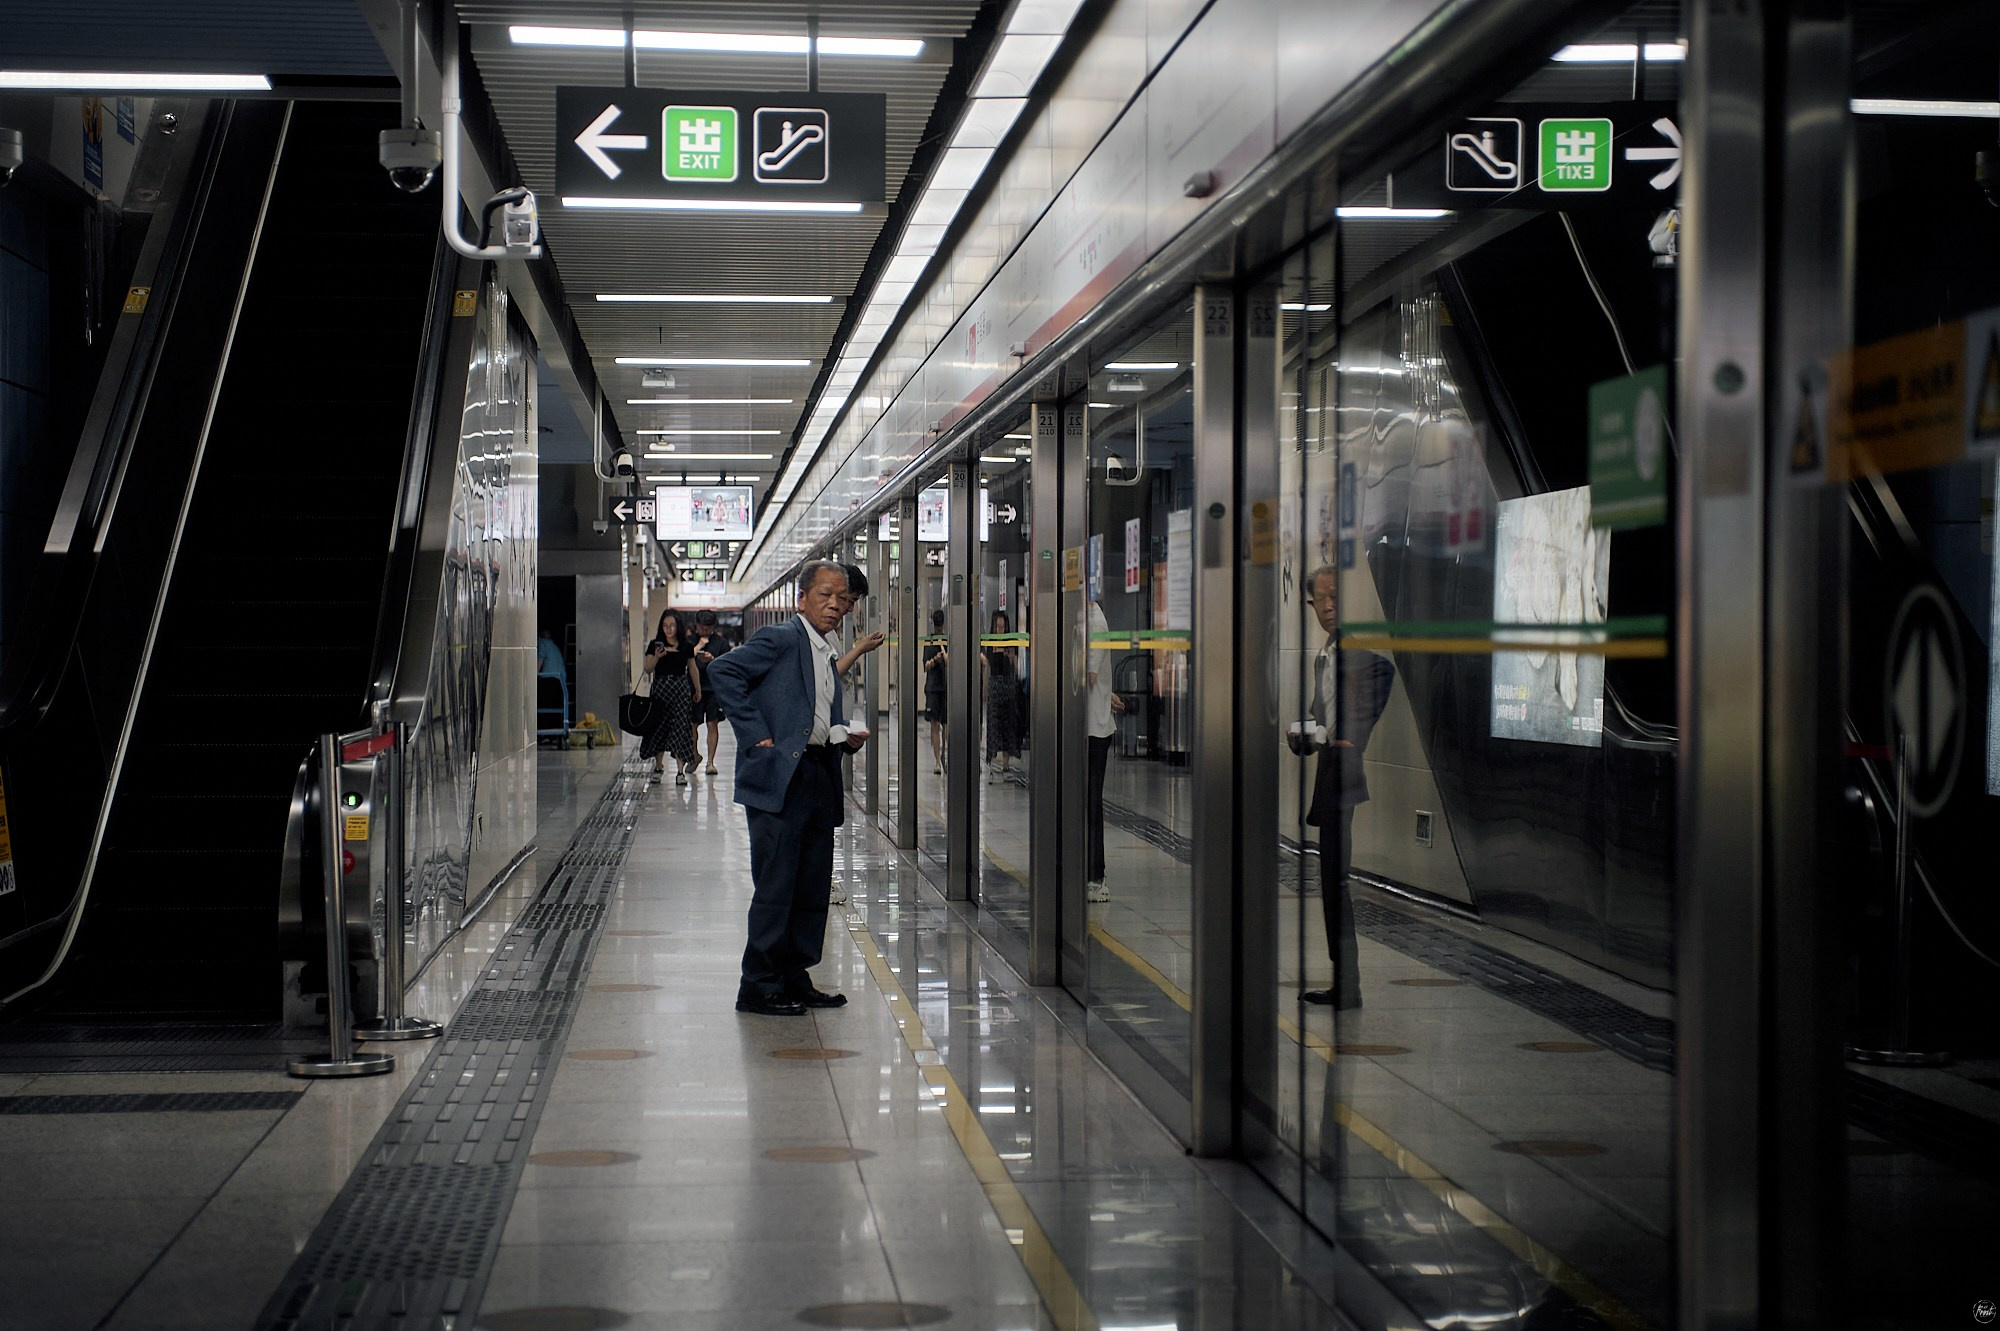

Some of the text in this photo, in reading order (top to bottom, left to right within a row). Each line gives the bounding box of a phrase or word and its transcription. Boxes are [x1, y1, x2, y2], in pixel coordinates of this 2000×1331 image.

[680, 118, 721, 153] 出
[679, 154, 721, 170] EXIT
[1208, 306, 1228, 320] 22
[1040, 416, 1053, 426] 21
